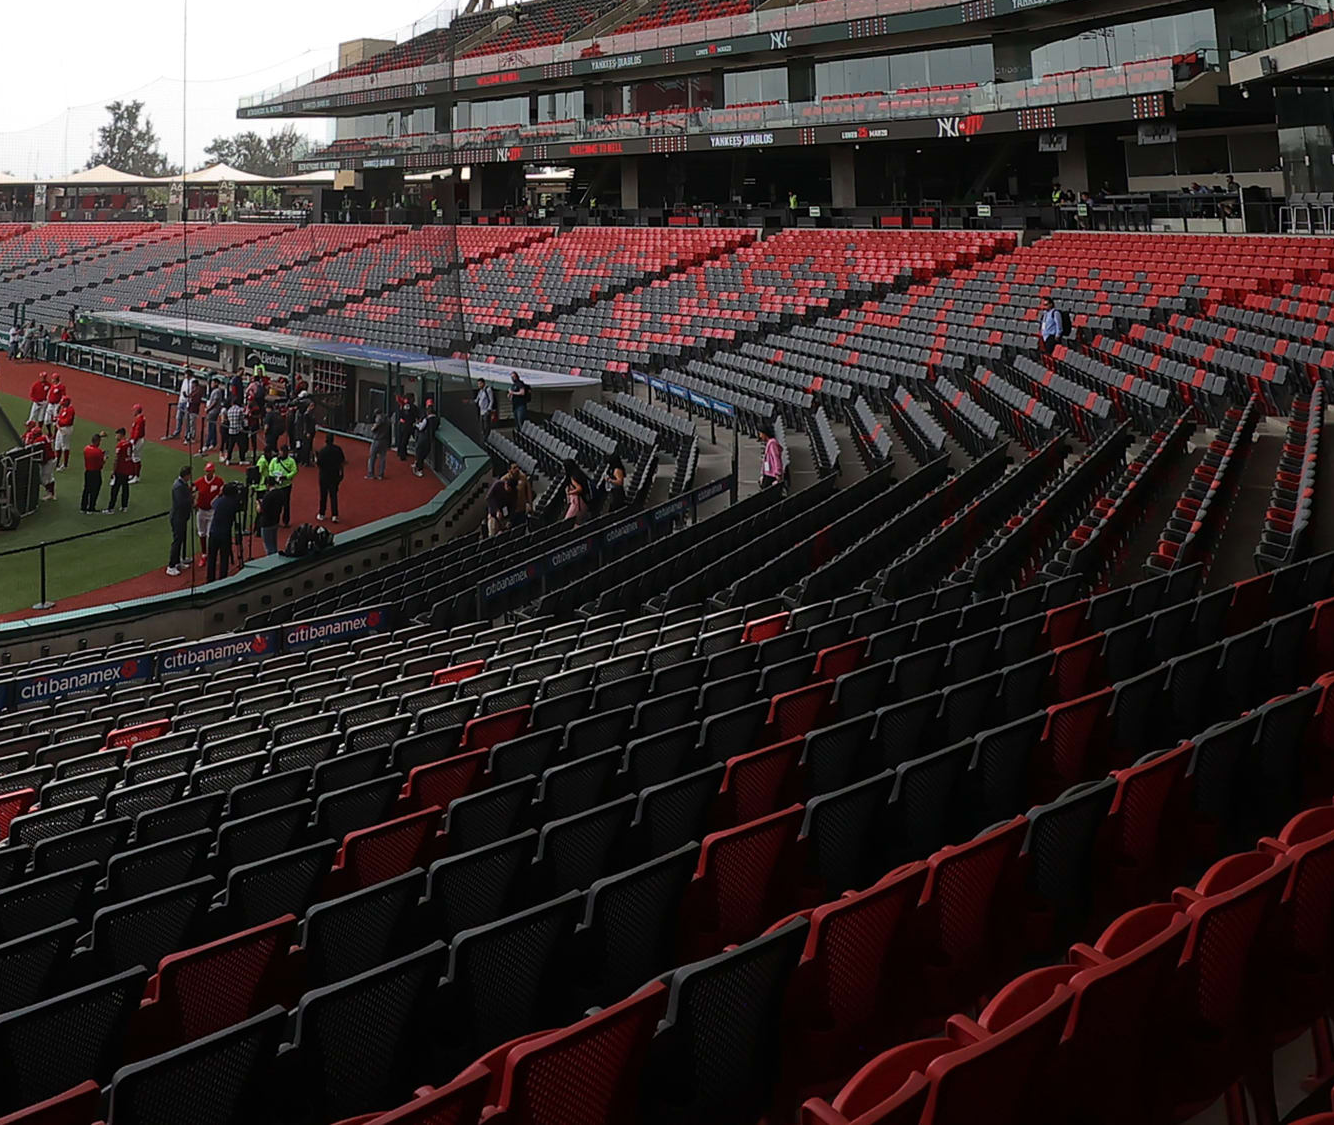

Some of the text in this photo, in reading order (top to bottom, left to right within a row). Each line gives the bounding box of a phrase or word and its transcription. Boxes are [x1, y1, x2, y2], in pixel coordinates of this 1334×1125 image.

[287, 616, 367, 644] citibanamex
[164, 641, 252, 669] citibanamex
[21, 665, 121, 700] citibanamex
